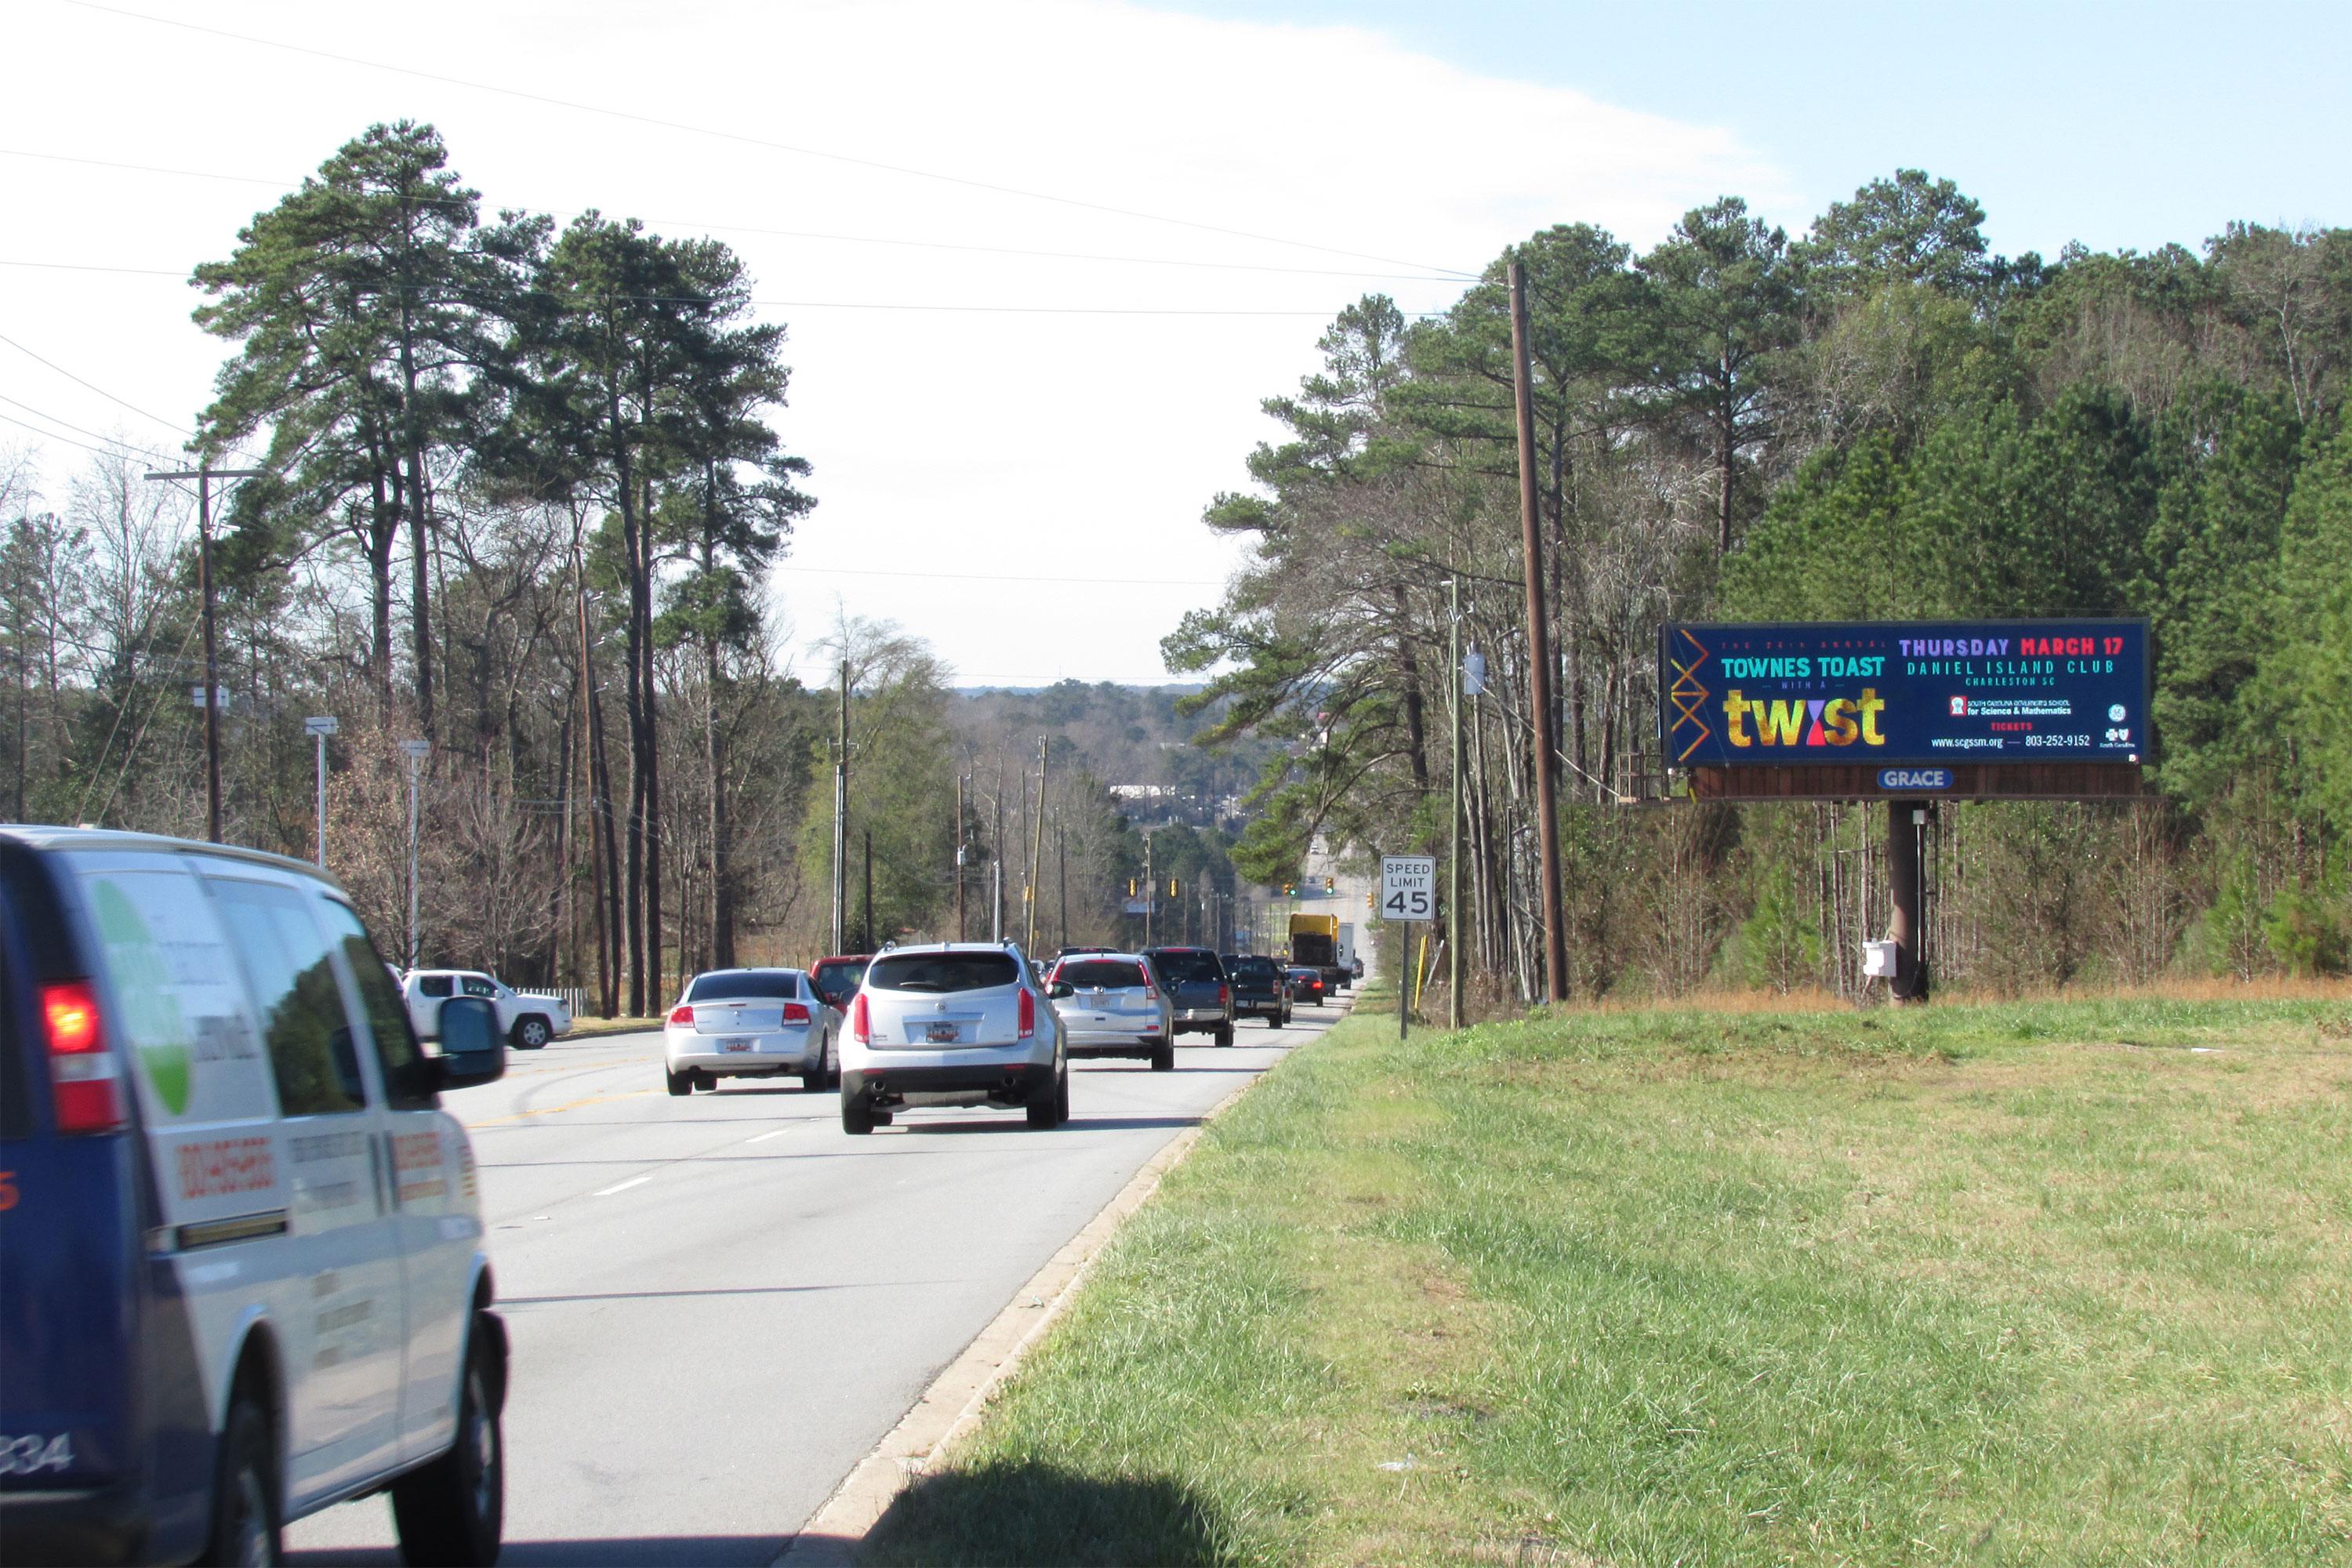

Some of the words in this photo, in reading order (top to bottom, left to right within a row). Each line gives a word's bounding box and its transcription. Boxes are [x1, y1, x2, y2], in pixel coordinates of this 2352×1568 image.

[1899, 639, 2009, 656] THURSDAY
[2020, 638, 2094, 655] MARCH
[2103, 637, 2123, 655] 17
[1721, 658, 1810, 678] TOWNES
[1817, 656, 1886, 677] TOAST
[1907, 662, 1973, 675] DANIEL
[1987, 661, 2054, 674] ISLAND
[2067, 660, 2114, 673] CLUB
[1965, 677, 2035, 686] CHARLESTON
[2042, 677, 2055, 686] SC
[1722, 688, 1886, 747] twist
[1967, 707, 1979, 716] for
[2022, 706, 2072, 715] Mathematics
[1991, 722, 2033, 731] TICKETS
[1931, 738, 2004, 749] www.scgssm.org
[2025, 735, 2090, 746] 803-252-9152
[1884, 771, 1944, 786] GRACE
[1386, 863, 1430, 874] SPEED
[1391, 877, 1425, 887] LIMIT
[1386, 891, 1428, 914] 45
